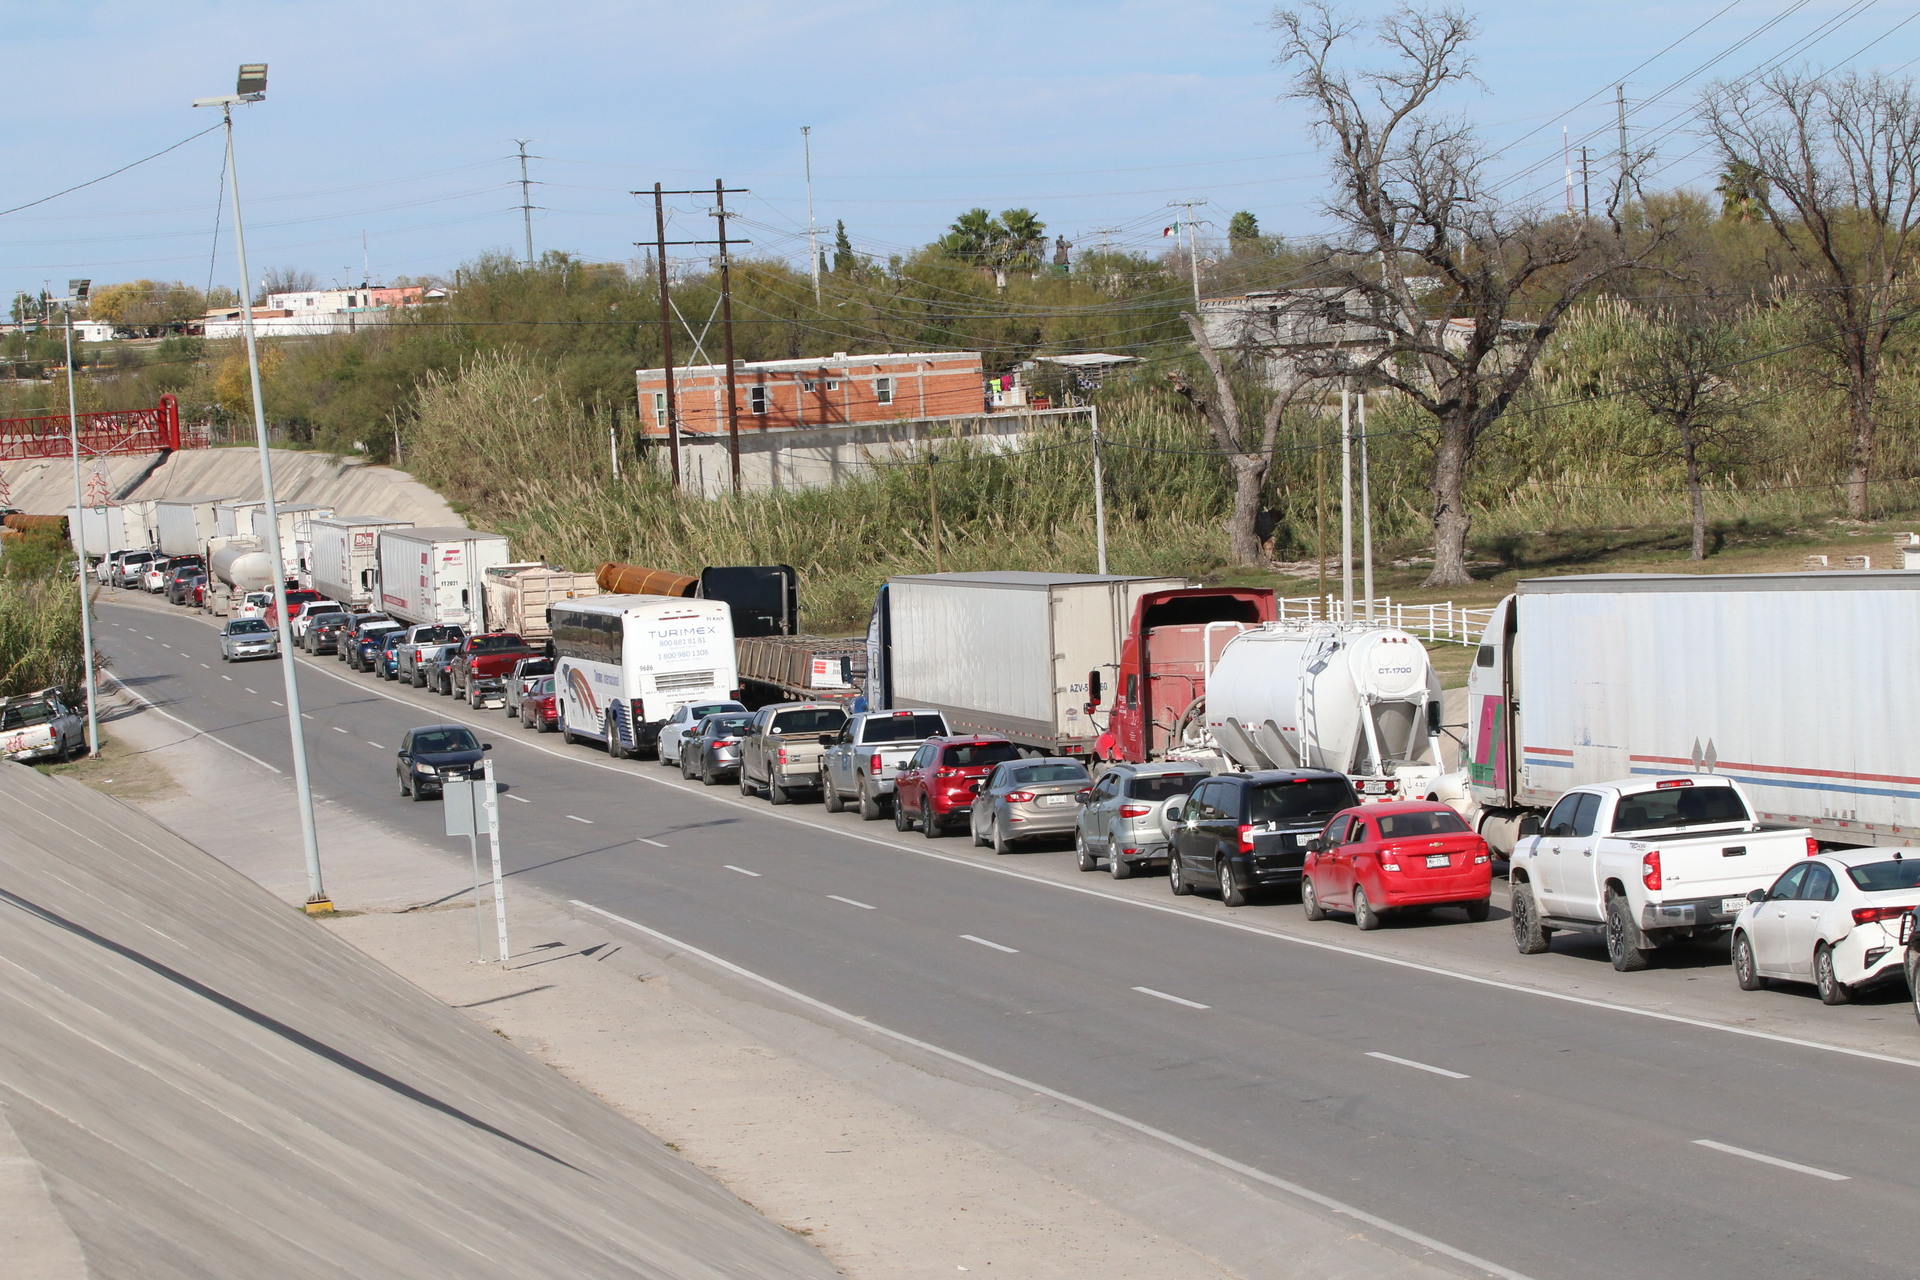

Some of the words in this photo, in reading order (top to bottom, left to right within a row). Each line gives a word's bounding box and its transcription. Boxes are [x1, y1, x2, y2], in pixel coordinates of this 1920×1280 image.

[648, 626, 716, 638] TURIMEX
[664, 652, 676, 660] 800
[692, 648, 709, 657] 1308
